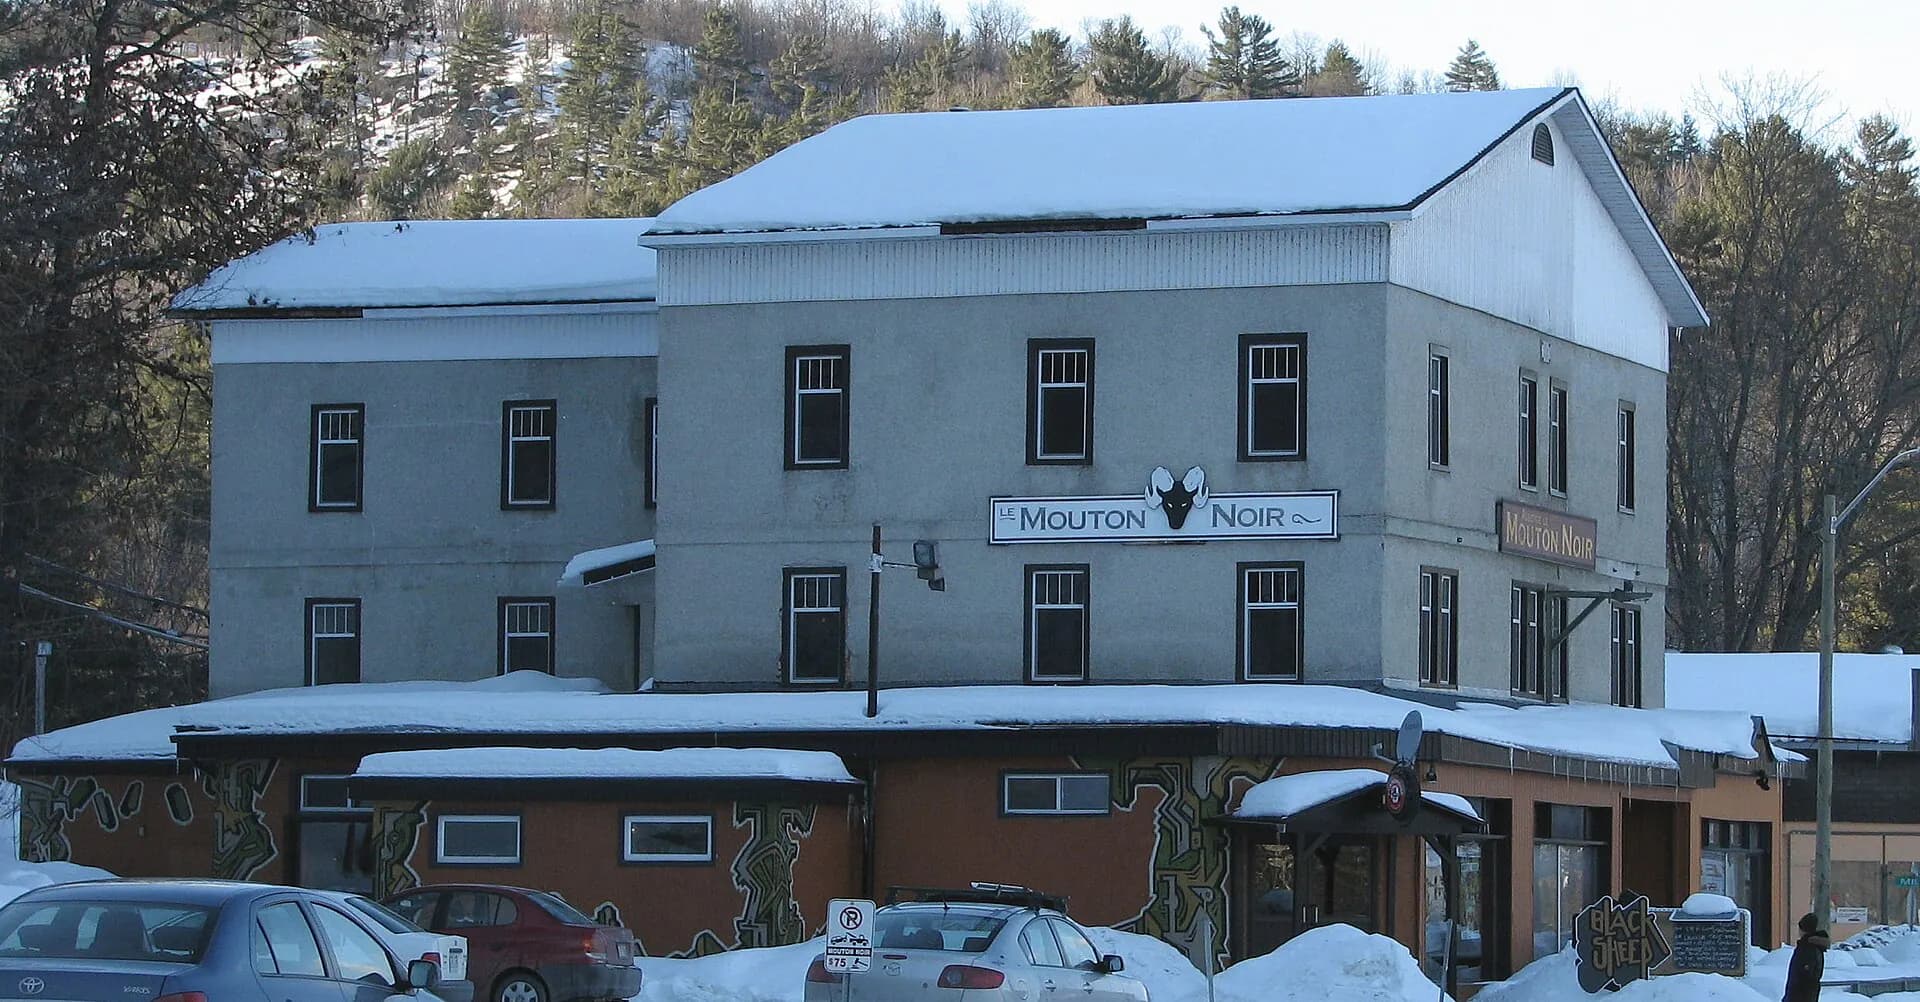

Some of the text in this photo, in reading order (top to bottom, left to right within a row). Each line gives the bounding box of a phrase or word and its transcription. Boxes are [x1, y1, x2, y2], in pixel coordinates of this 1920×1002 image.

[1000, 503, 1285, 531] LE MOUTON NOIR
[1506, 511, 1593, 560] MOUTON NOIR
[1591, 900, 1668, 954] BLACK
[1593, 936, 1653, 979] SHEEP
